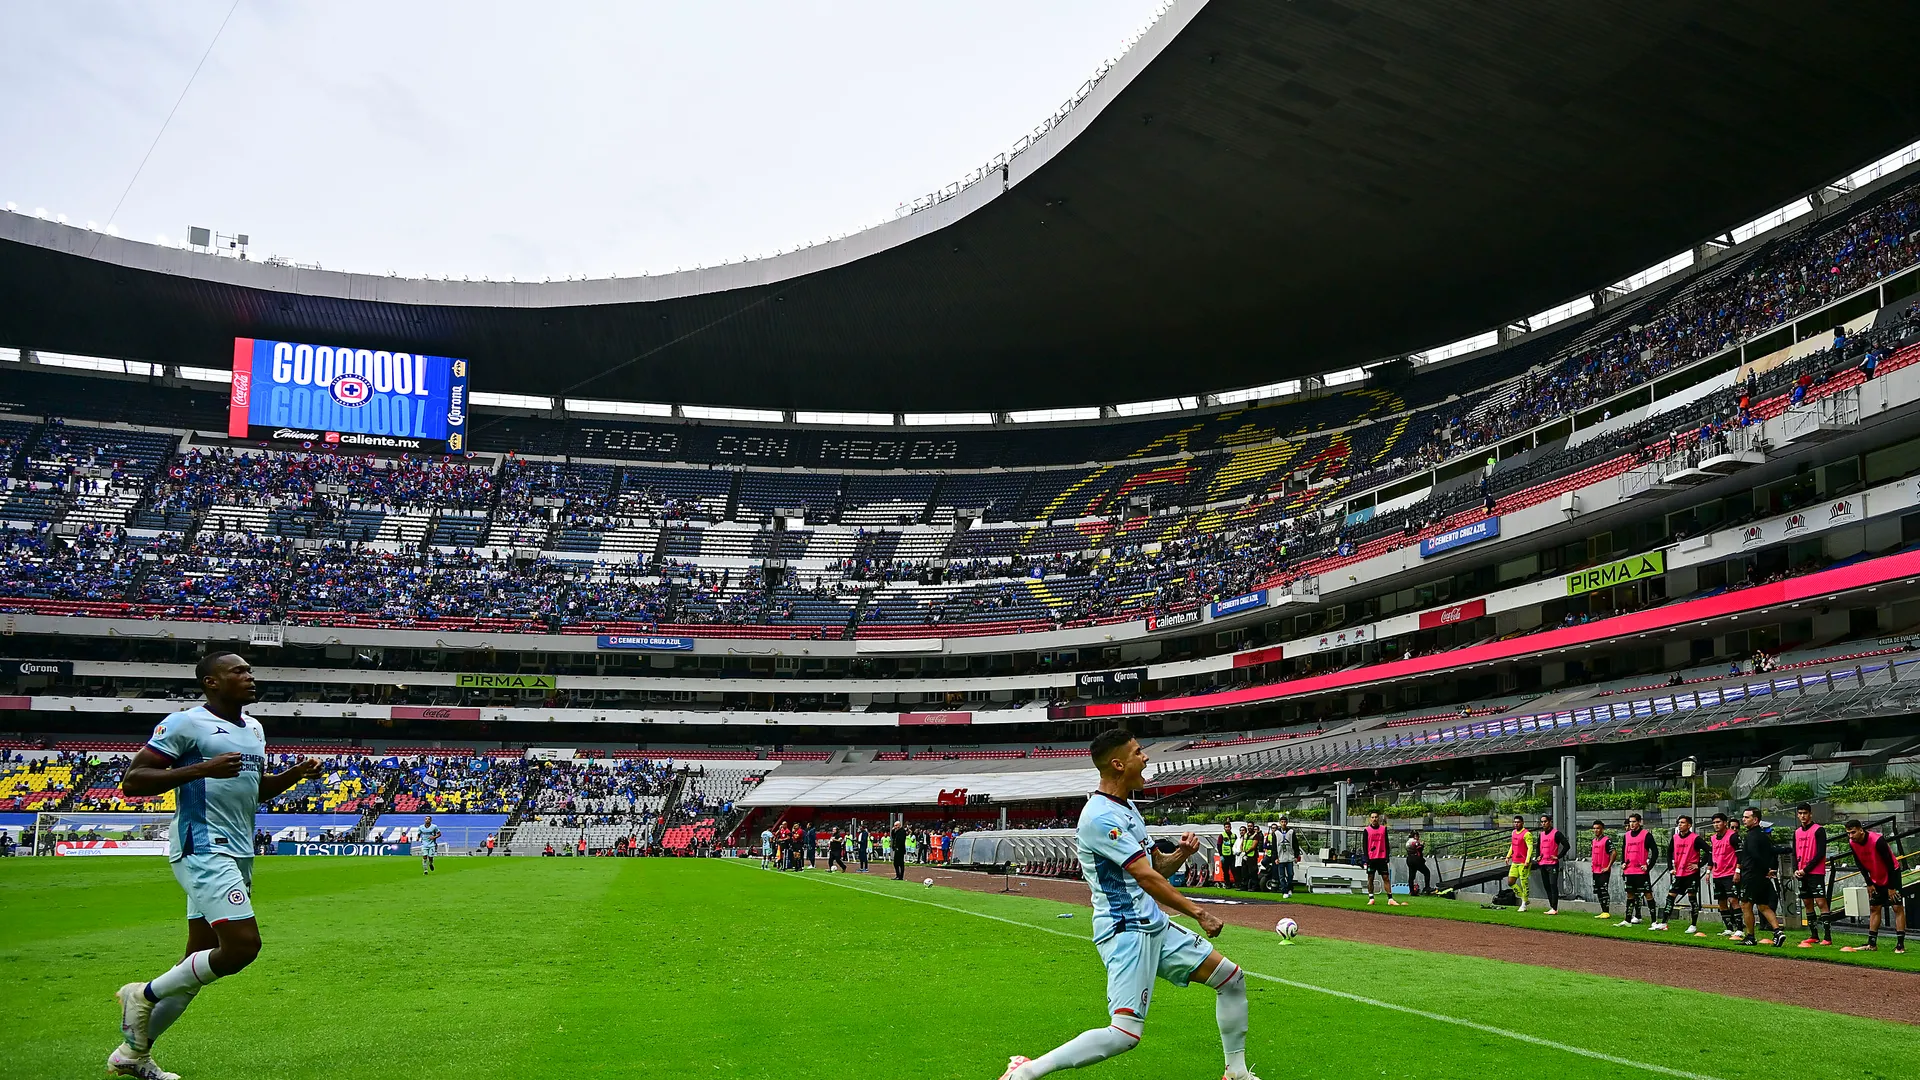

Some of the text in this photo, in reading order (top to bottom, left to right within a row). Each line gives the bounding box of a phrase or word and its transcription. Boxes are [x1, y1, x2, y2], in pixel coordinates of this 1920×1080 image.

[447, 384, 464, 426] Corona
[340, 434, 420, 449] caliente.mx
[581, 428, 958, 460] TODO CON MEDIDA
[1435, 523, 1486, 546] CEMENTO CRUZ AZUL
[1570, 564, 1632, 592] PIRMA
[1156, 610, 1198, 628] caliente.mx
[20, 662, 59, 674] Corona
[461, 675, 525, 687] PIRMA
[1080, 671, 1138, 686] Corona Corona
[1214, 862, 1220, 874] G
